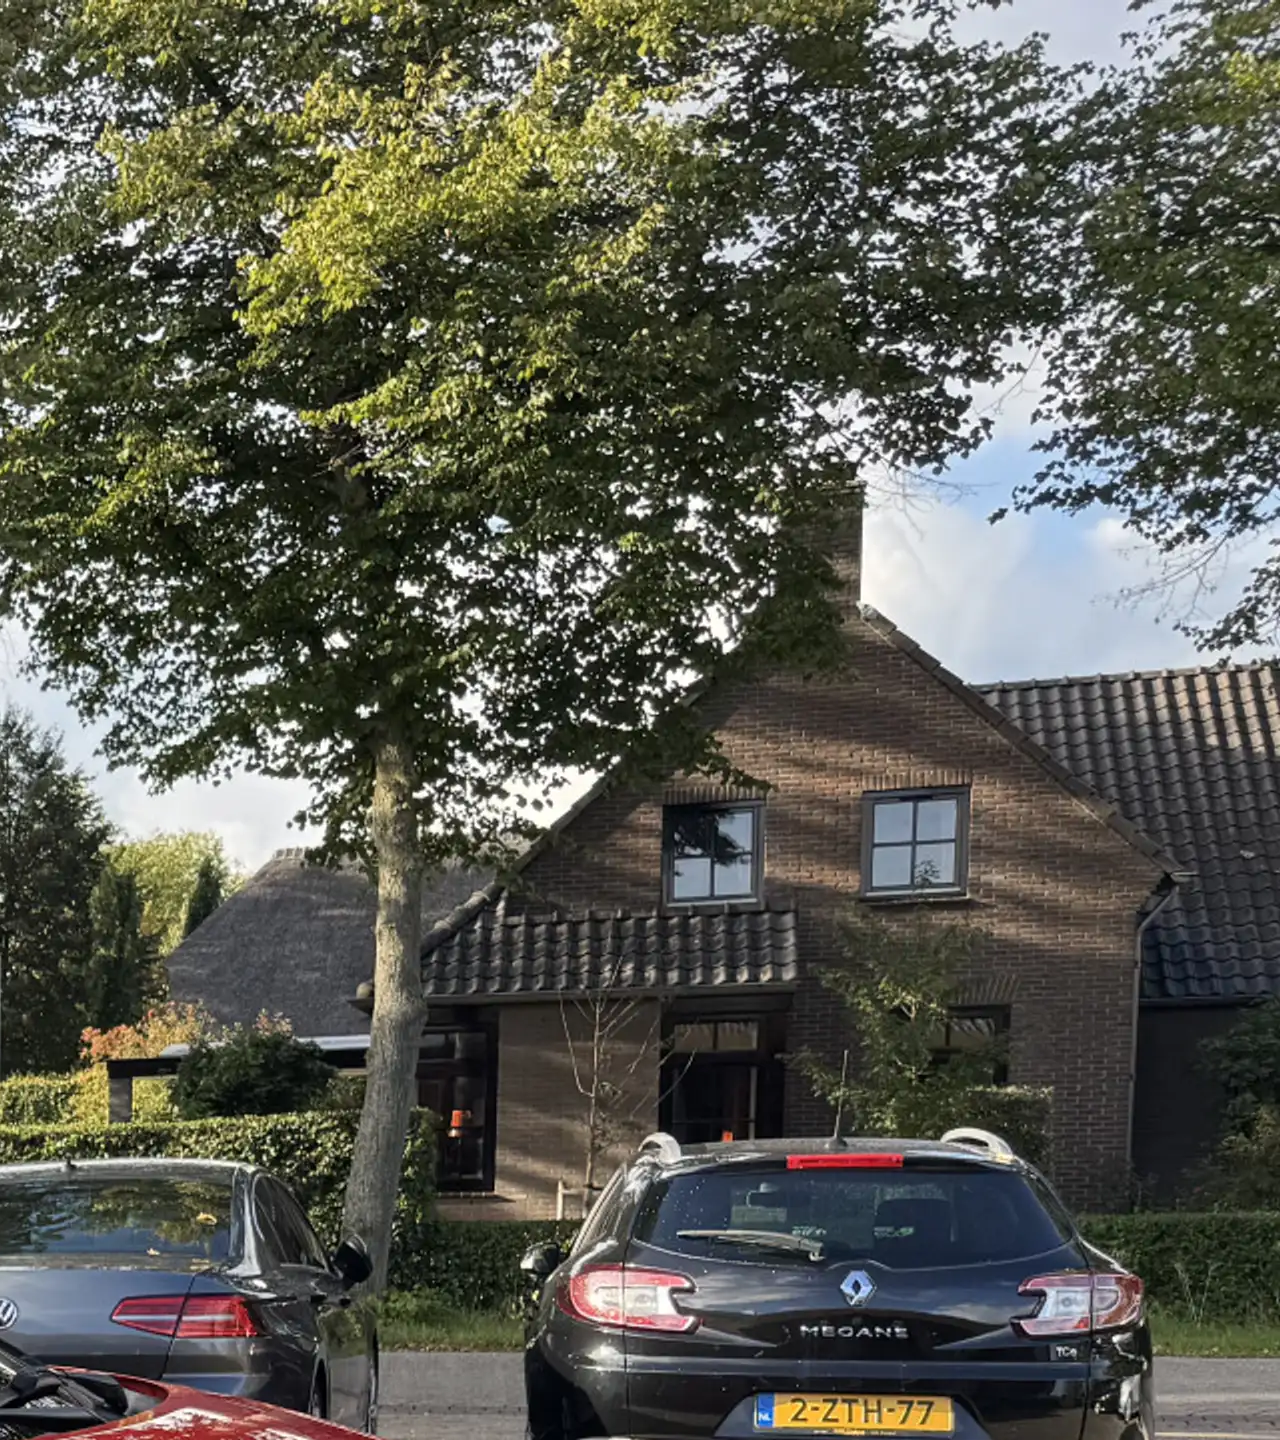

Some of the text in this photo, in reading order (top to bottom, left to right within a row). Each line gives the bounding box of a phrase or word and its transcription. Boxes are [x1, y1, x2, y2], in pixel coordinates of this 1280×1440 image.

[800, 1325, 908, 1338] MEGANE
[758, 1397, 935, 1426] NL 2-ZTH-77
